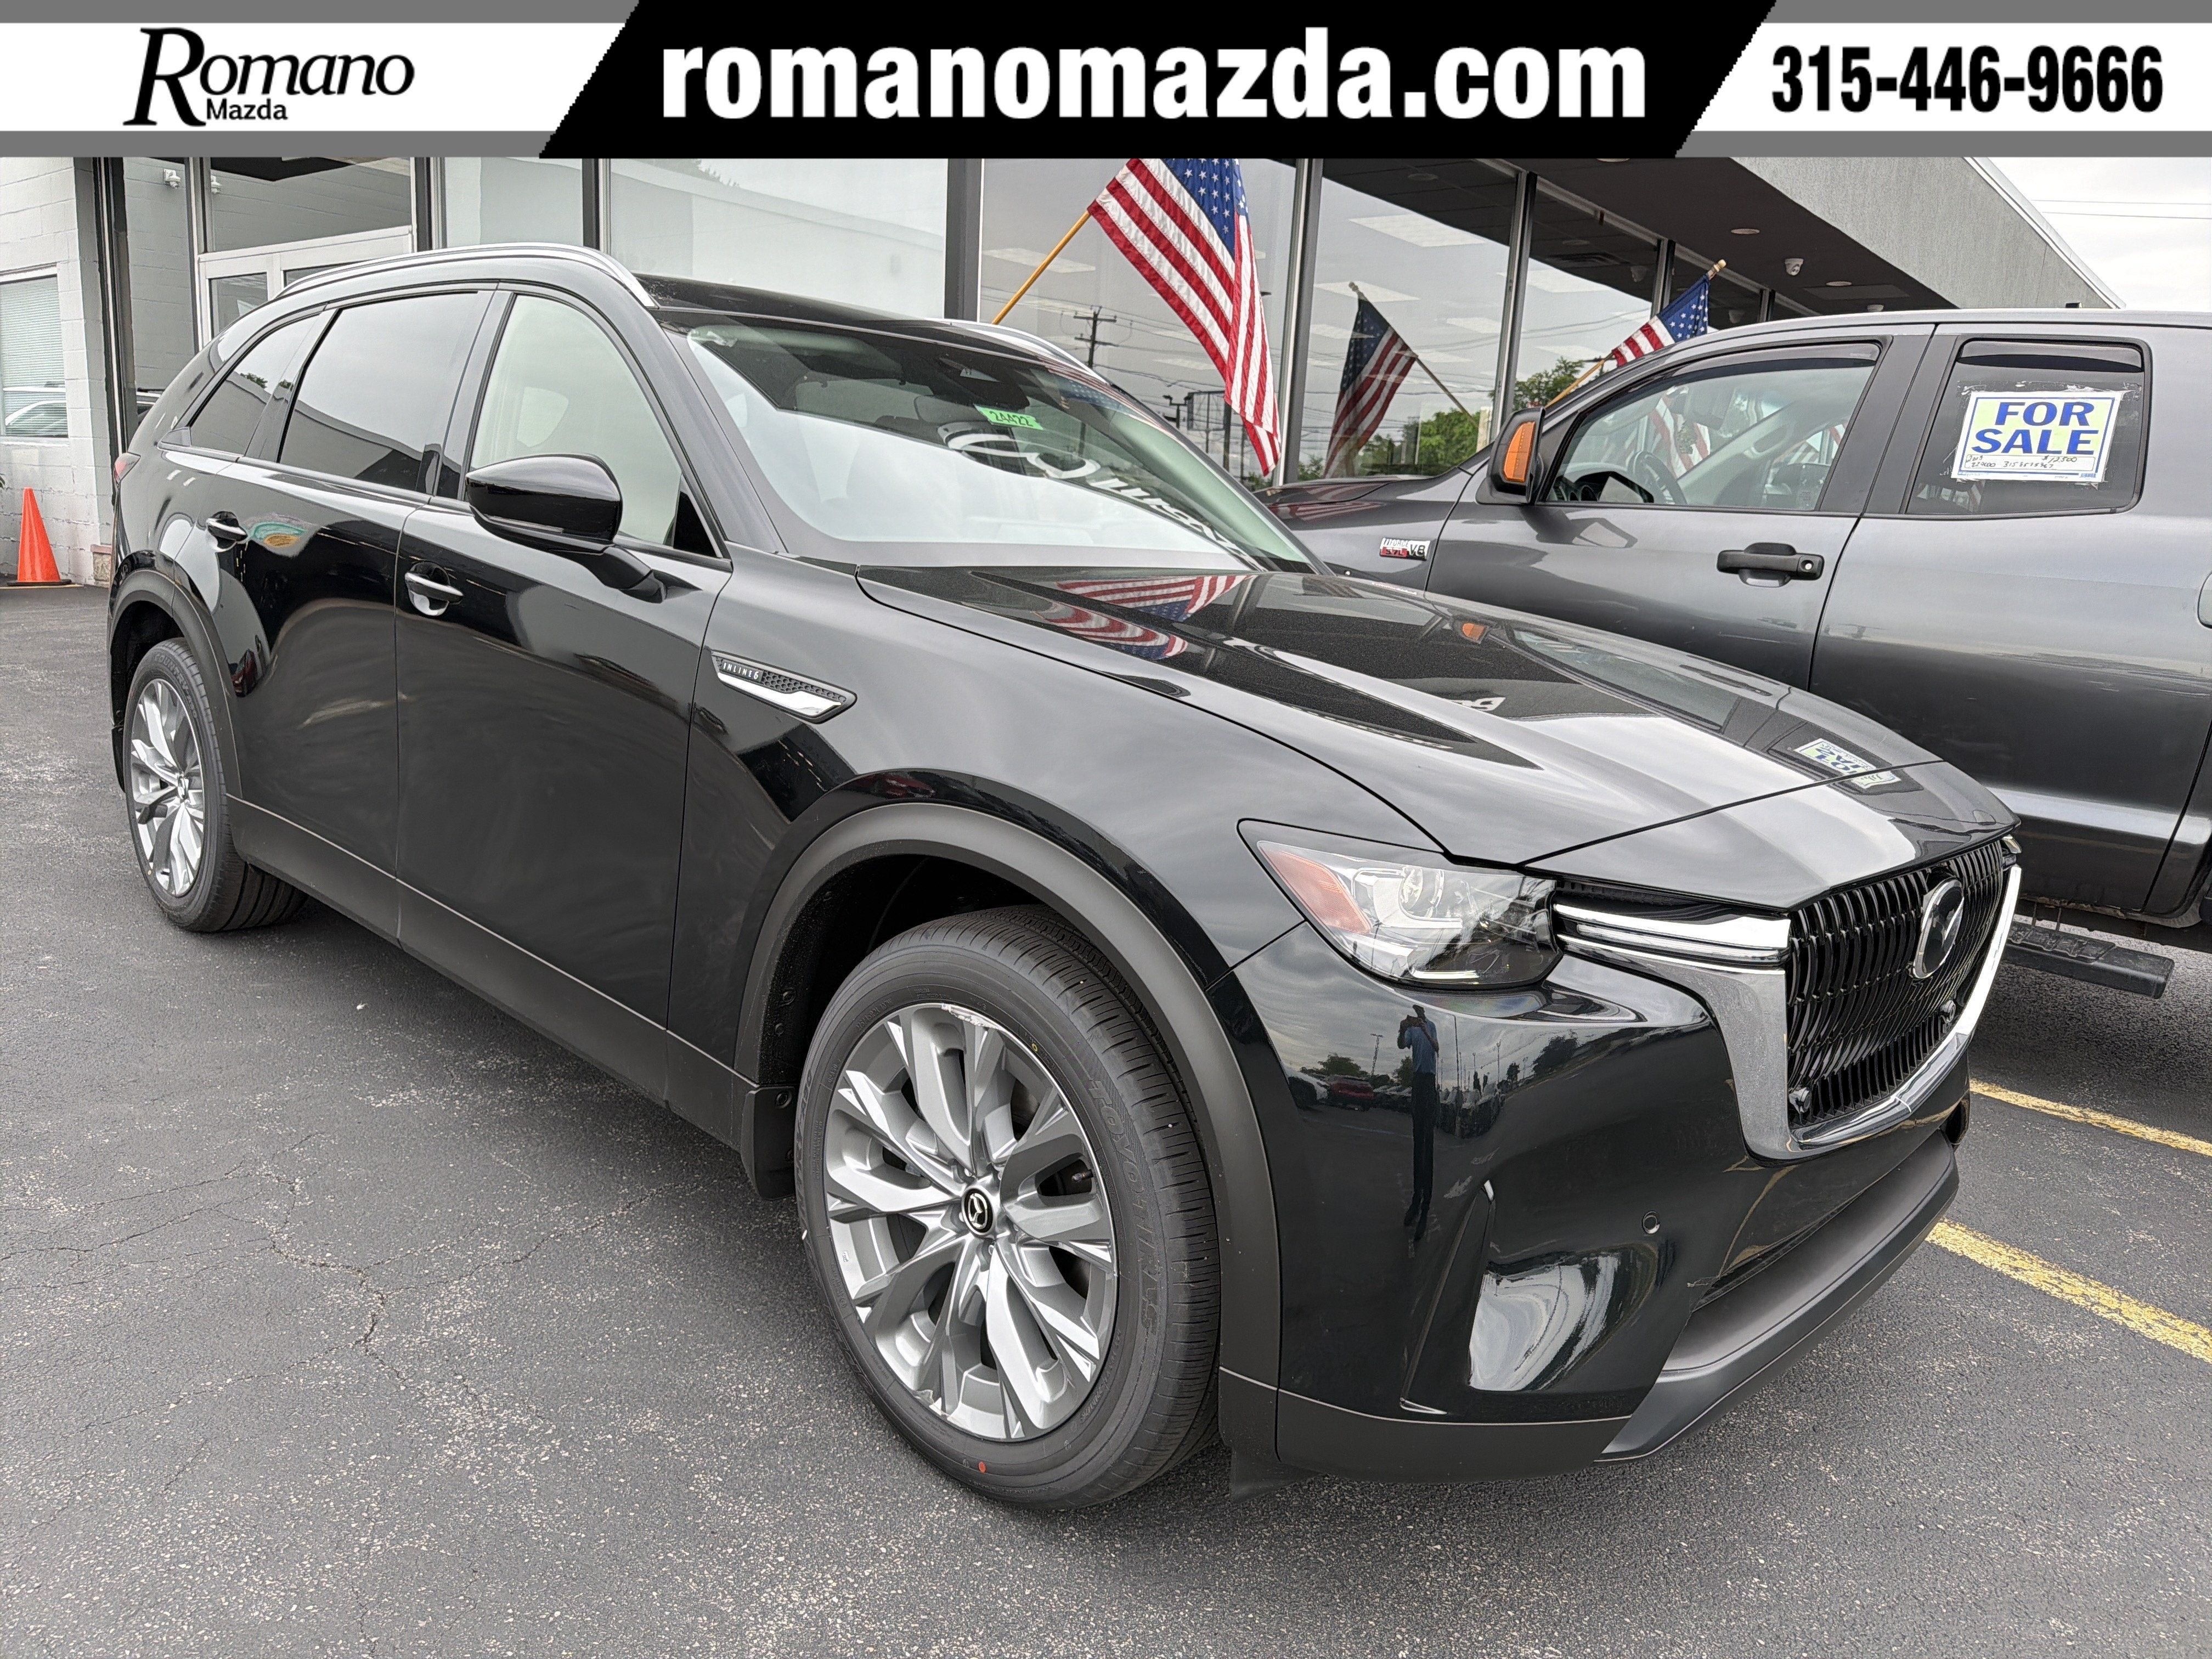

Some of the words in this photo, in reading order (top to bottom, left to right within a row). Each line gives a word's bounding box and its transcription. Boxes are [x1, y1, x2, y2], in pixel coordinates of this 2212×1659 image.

[989, 411, 1034, 427] 24422
[1995, 402, 2095, 426] FOR
[1971, 428, 2099, 455] SALE
[1409, 544, 1426, 557] V8
[1089, 1080, 1144, 1194] TOYO
